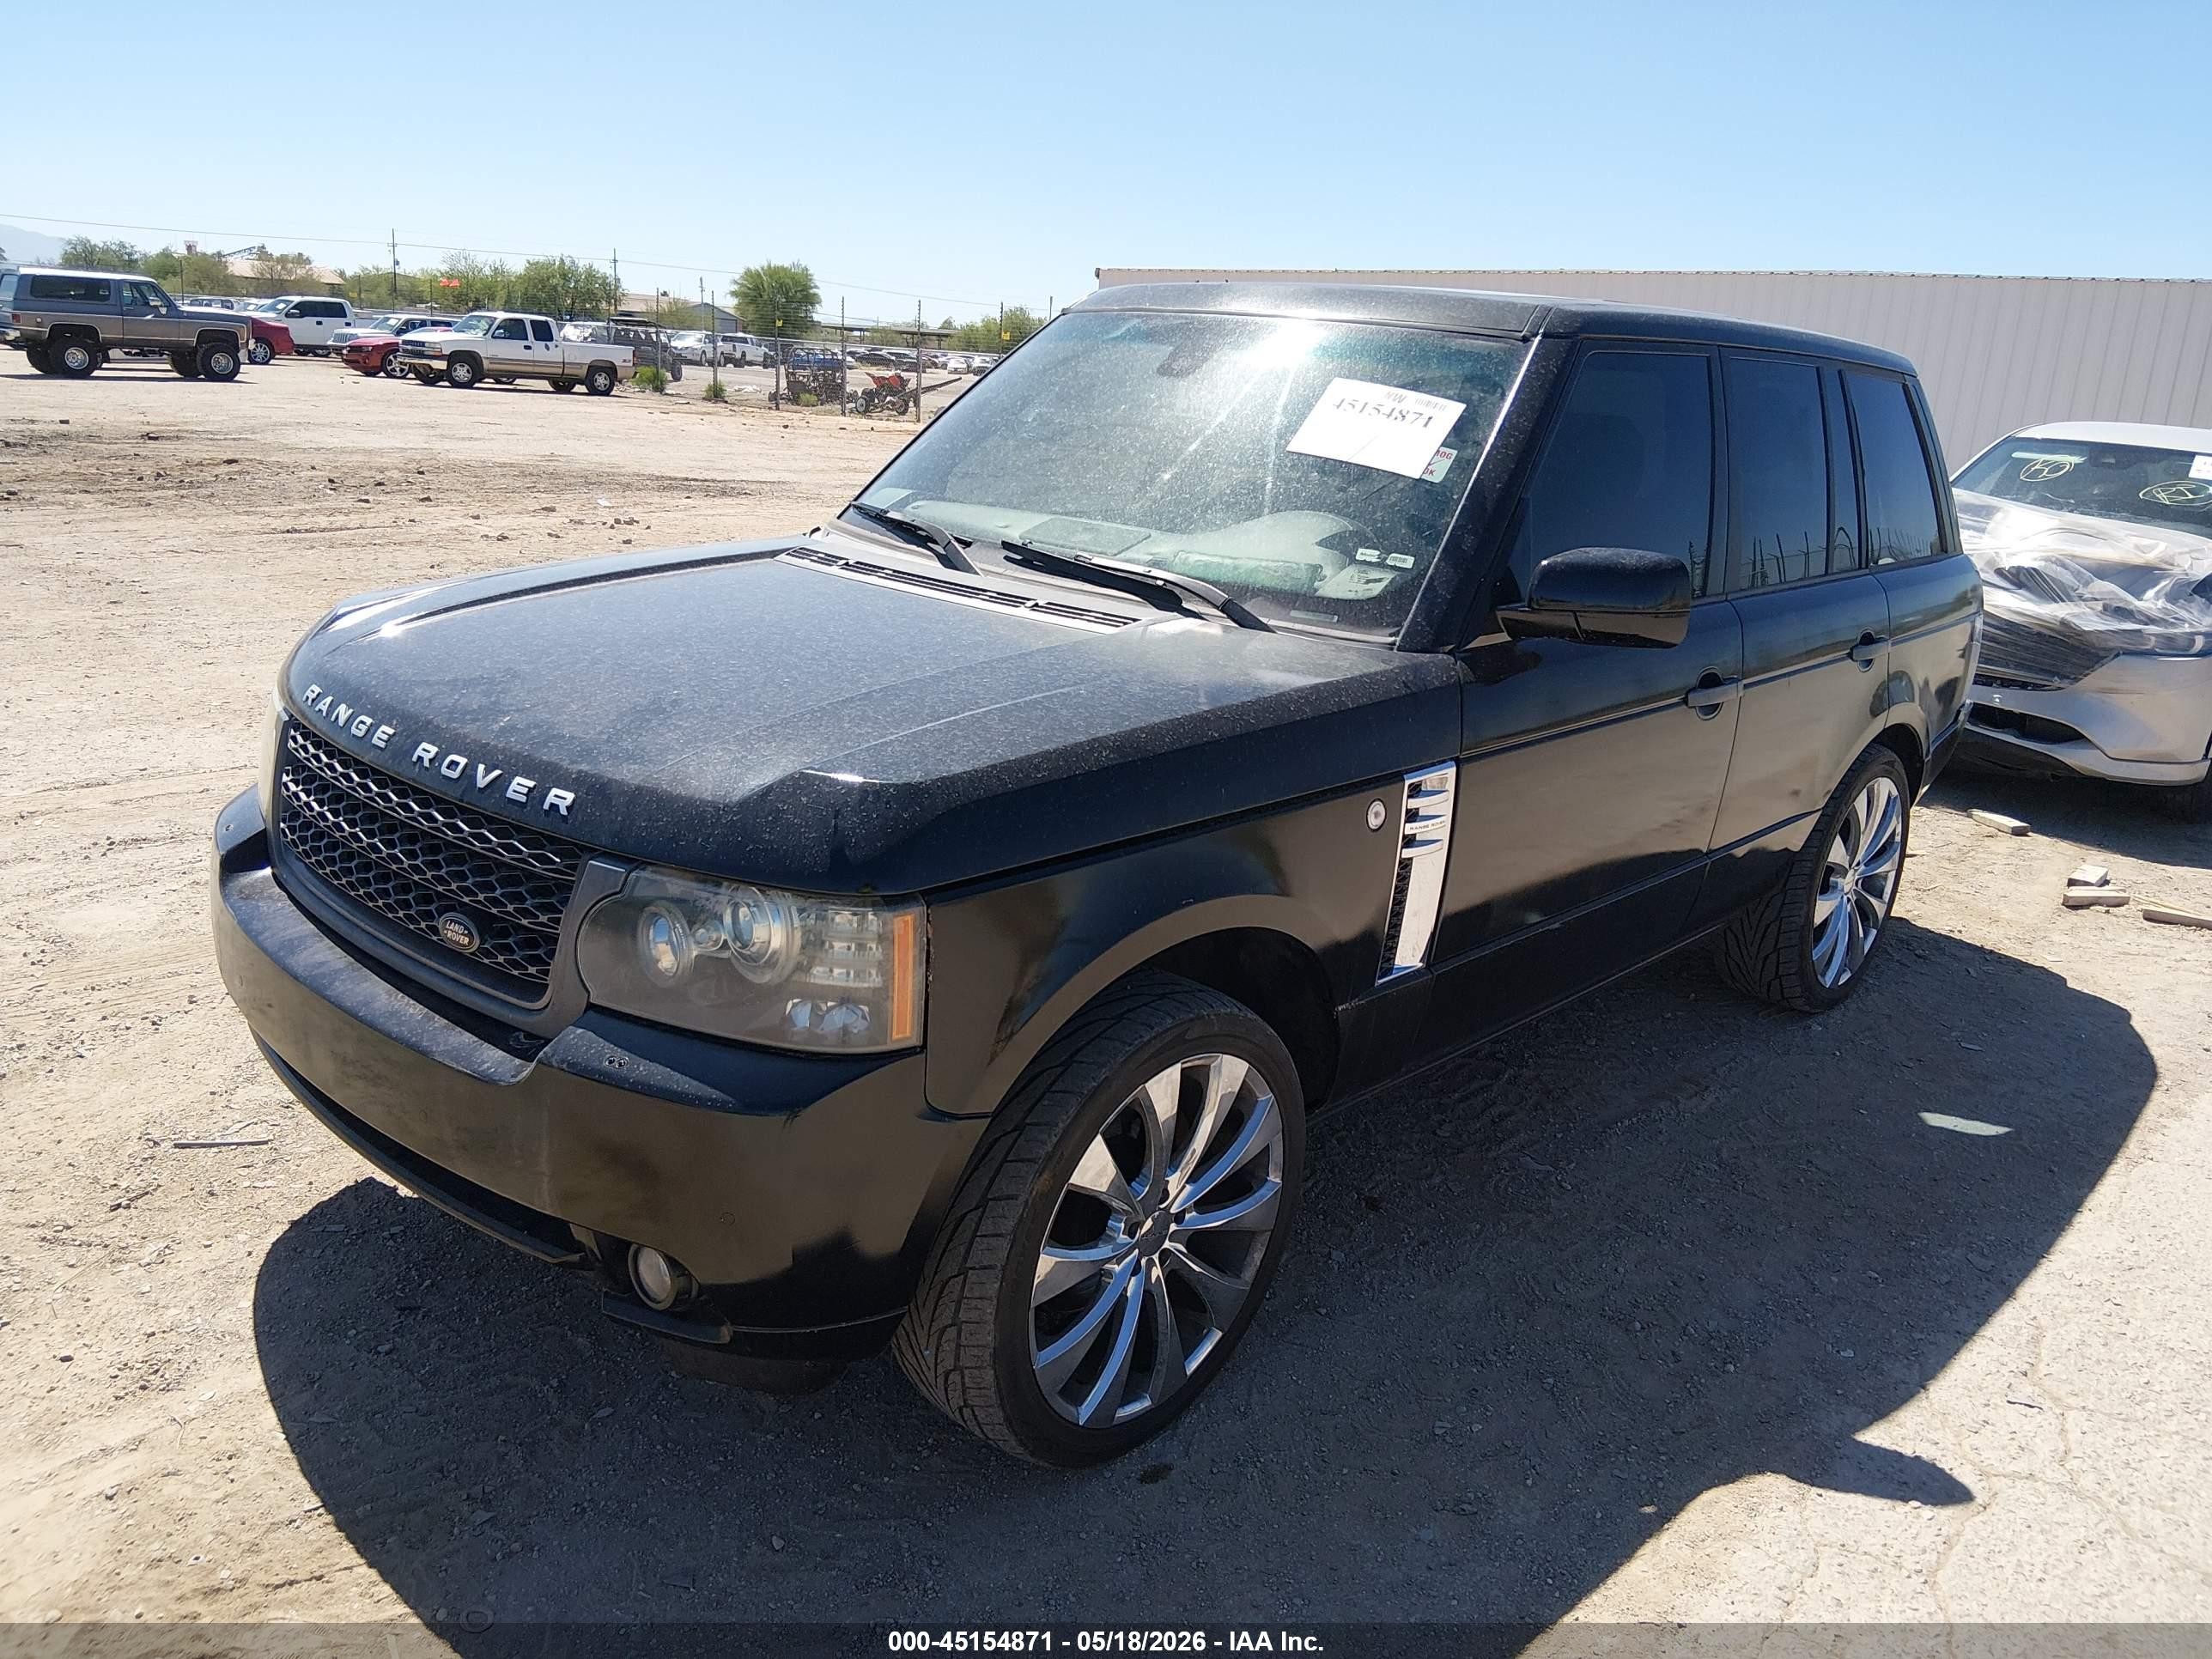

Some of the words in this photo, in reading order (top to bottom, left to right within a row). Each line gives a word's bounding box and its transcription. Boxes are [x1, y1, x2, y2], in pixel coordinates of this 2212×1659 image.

[302, 684, 396, 749] RANGE
[412, 741, 575, 817] ROVER
[446, 921, 465, 934] LAND
[447, 930, 470, 945] ROVER
